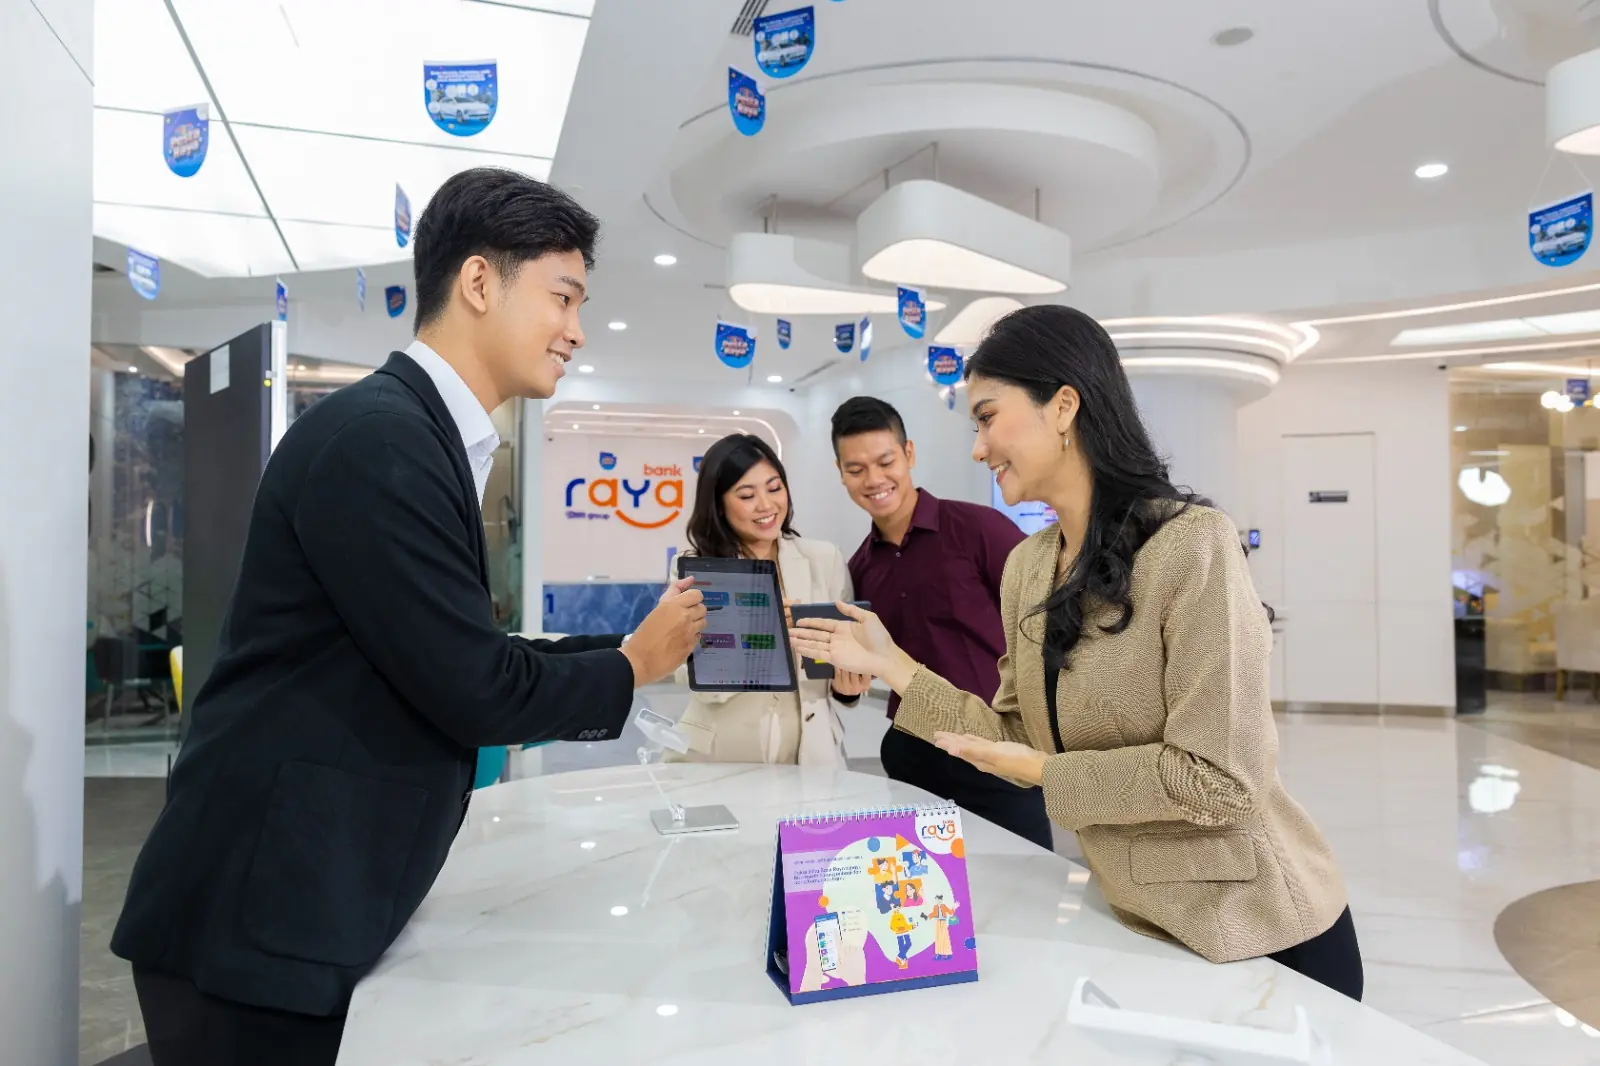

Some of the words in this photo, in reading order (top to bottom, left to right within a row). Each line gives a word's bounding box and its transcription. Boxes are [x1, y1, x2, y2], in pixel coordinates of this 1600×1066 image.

[643, 463, 682, 477] bank
[565, 478, 683, 508] raya
[545, 593, 554, 614] 1
[921, 823, 956, 837] raya
